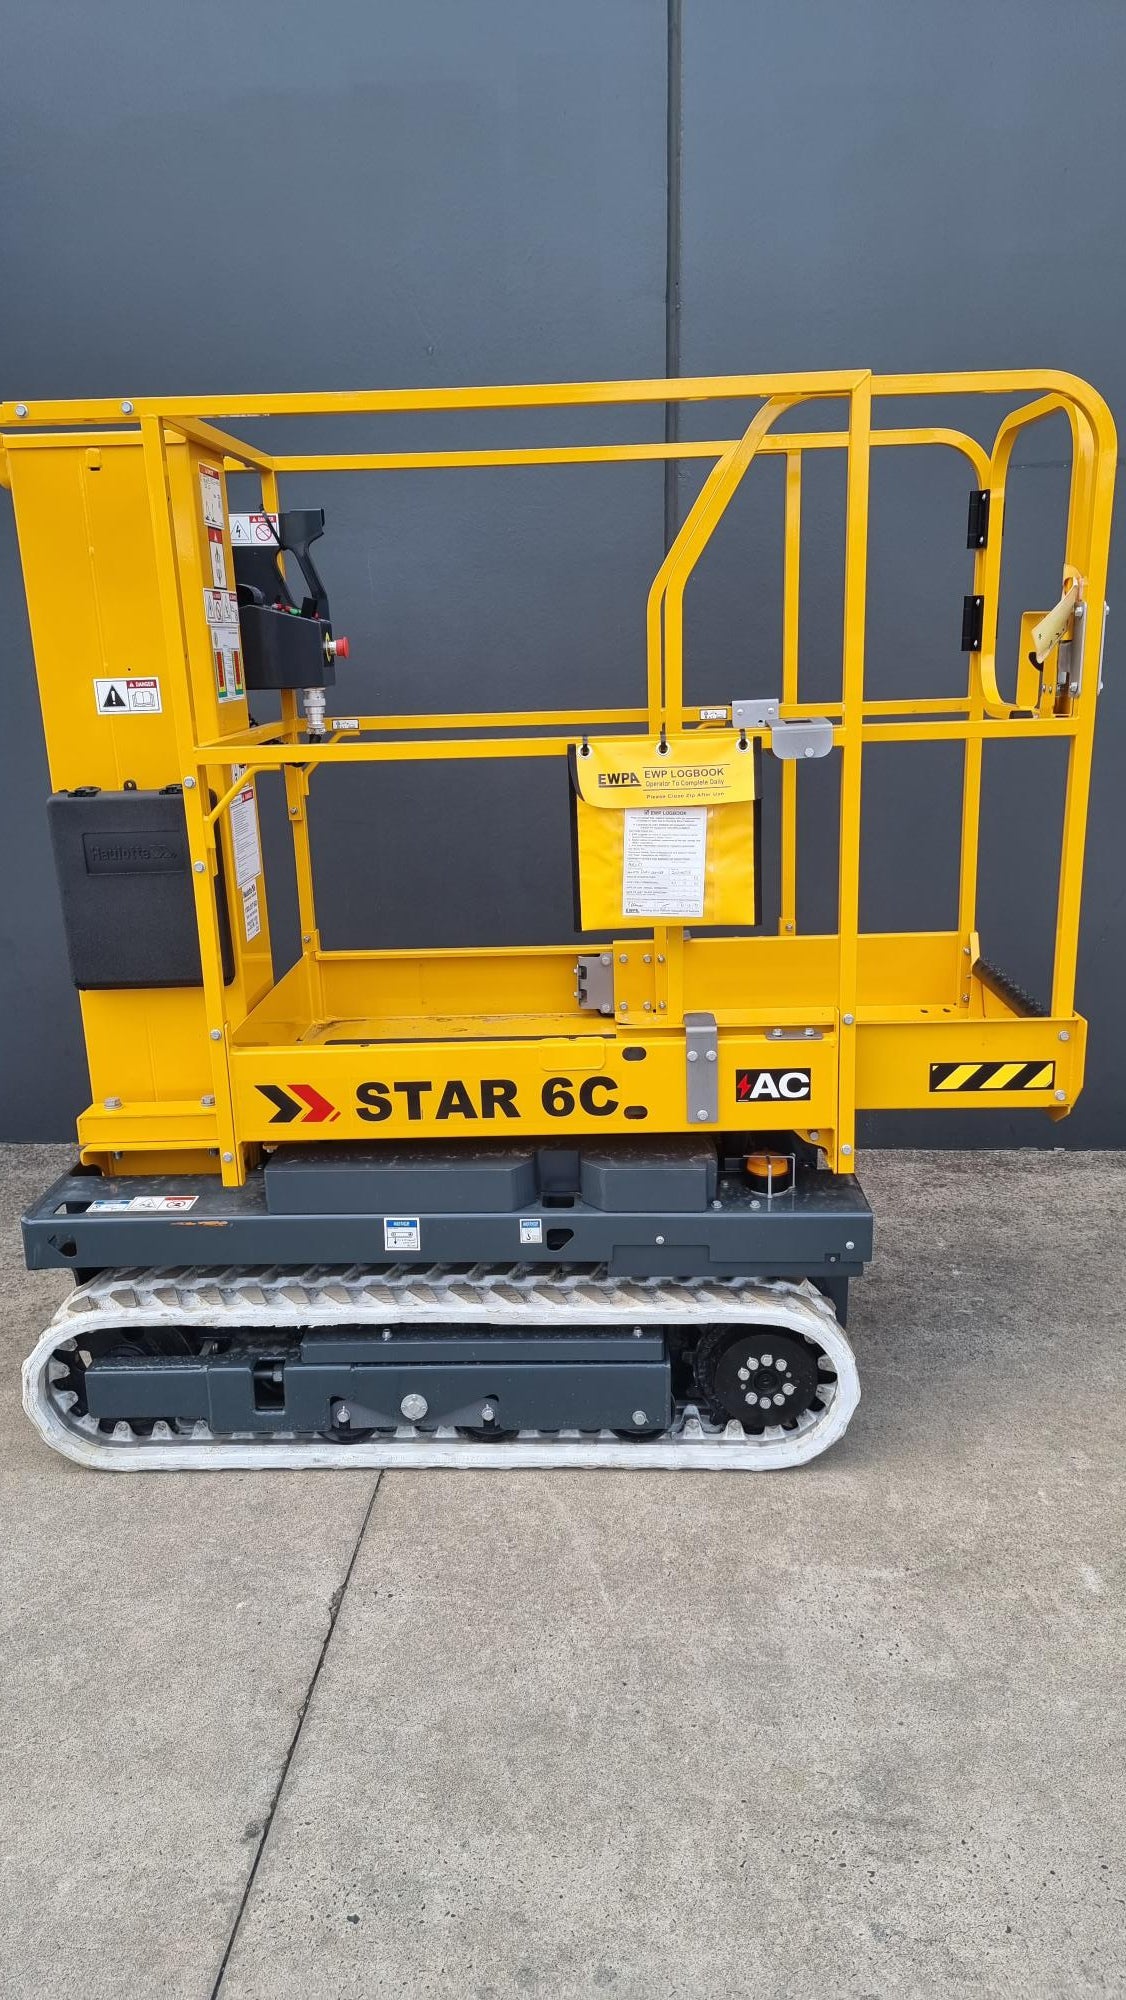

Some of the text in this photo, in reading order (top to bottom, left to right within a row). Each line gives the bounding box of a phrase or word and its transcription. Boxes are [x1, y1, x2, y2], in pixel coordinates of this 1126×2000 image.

[598, 773, 640, 785] EWPA
[644, 768, 724, 778] EWP LOGBOOK
[645, 780, 671, 788] Operator
[680, 779, 708, 787] Complete
[749, 1072, 810, 1099] AC
[355, 1076, 619, 1122] STAR 6C
